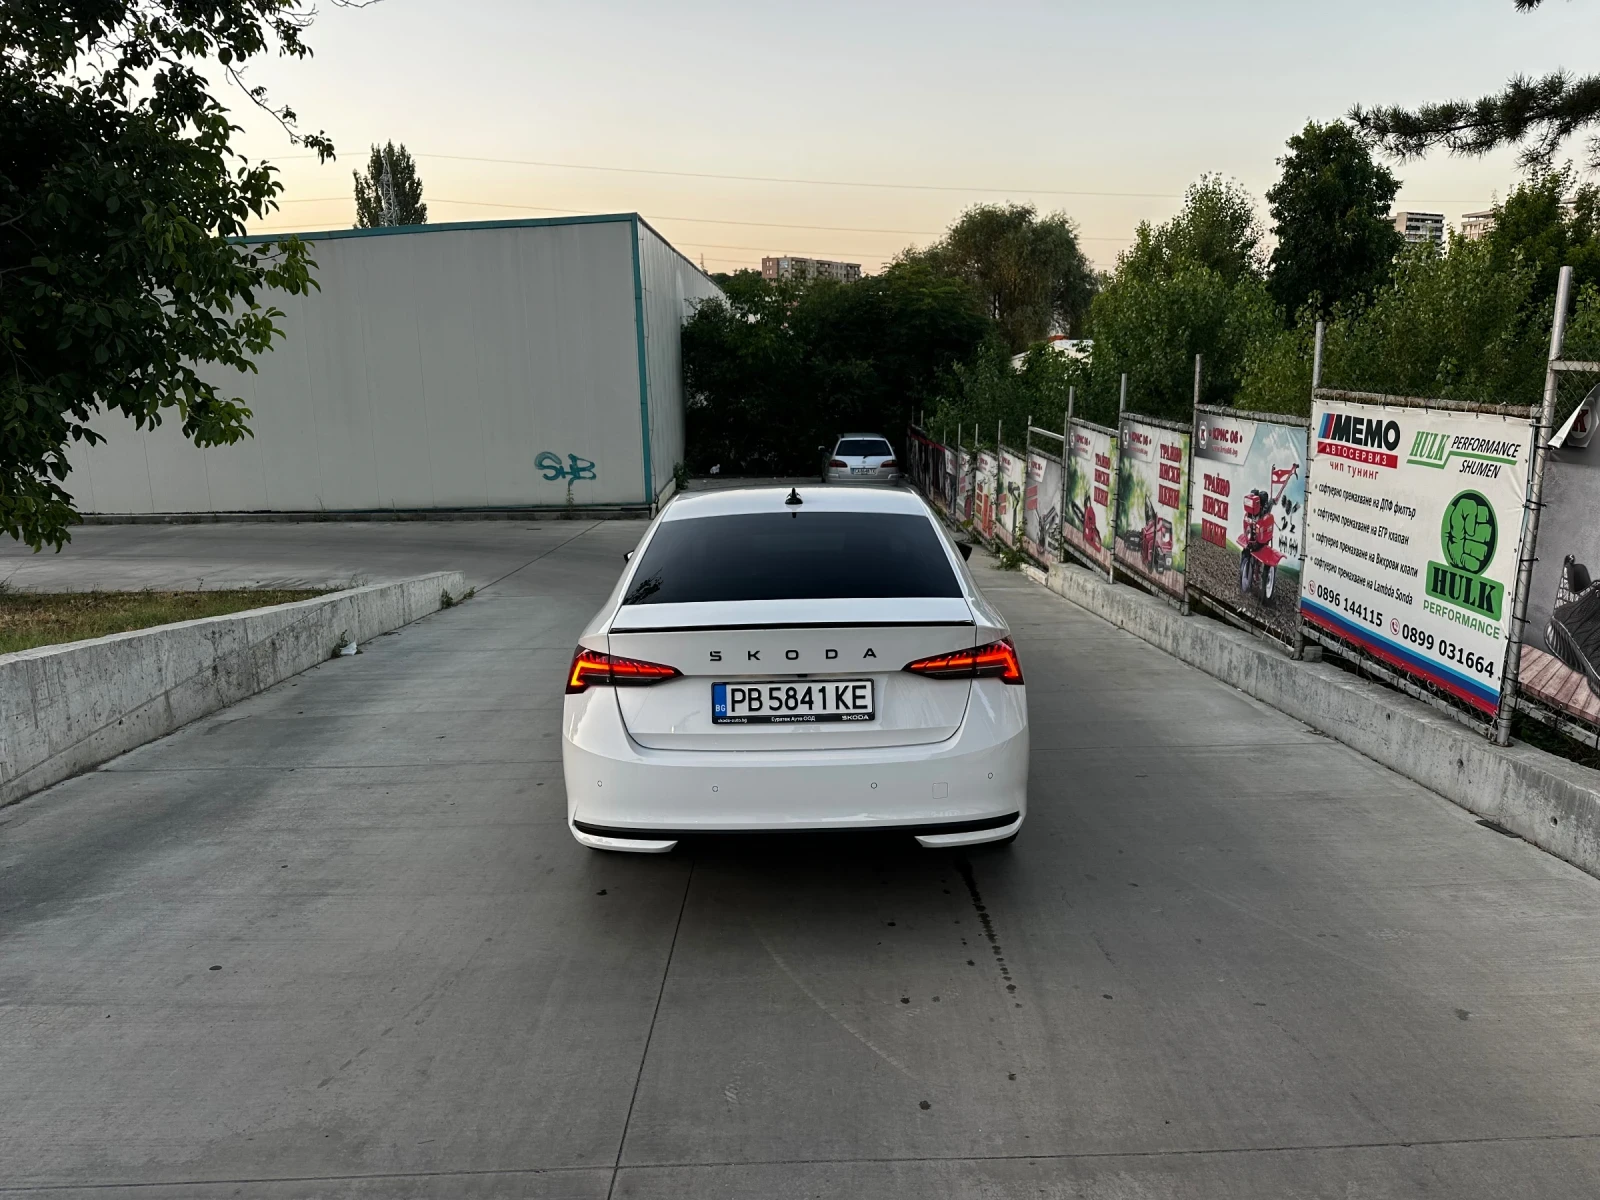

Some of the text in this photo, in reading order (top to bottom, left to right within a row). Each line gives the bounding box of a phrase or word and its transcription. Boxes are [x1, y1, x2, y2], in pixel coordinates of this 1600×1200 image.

[1330, 414, 1400, 451] MEMO
[1325, 444, 1387, 465] АВТОСЕРВИЗ
[1409, 431, 1521, 461] HULK PERFORMANCE
[1329, 460, 1379, 480] чип тунинг
[1459, 460, 1501, 479] SHUMEN
[1203, 473, 1230, 497] ТРАЙНО
[1202, 494, 1229, 521] НИСКИ
[1379, 498, 1393, 512] ДПФ
[1393, 501, 1416, 520] филтър
[1378, 525, 1388, 538] ЕГР
[1374, 580, 1394, 598] Lambda
[1395, 588, 1413, 605] Sonda
[1431, 566, 1496, 614] HULK
[1317, 584, 1383, 628] 0896 144115
[1423, 599, 1500, 640] PERFORMANCE
[709, 648, 877, 662] SKODA
[1402, 624, 1494, 678] 0899 031664
[715, 704, 726, 712] BG
